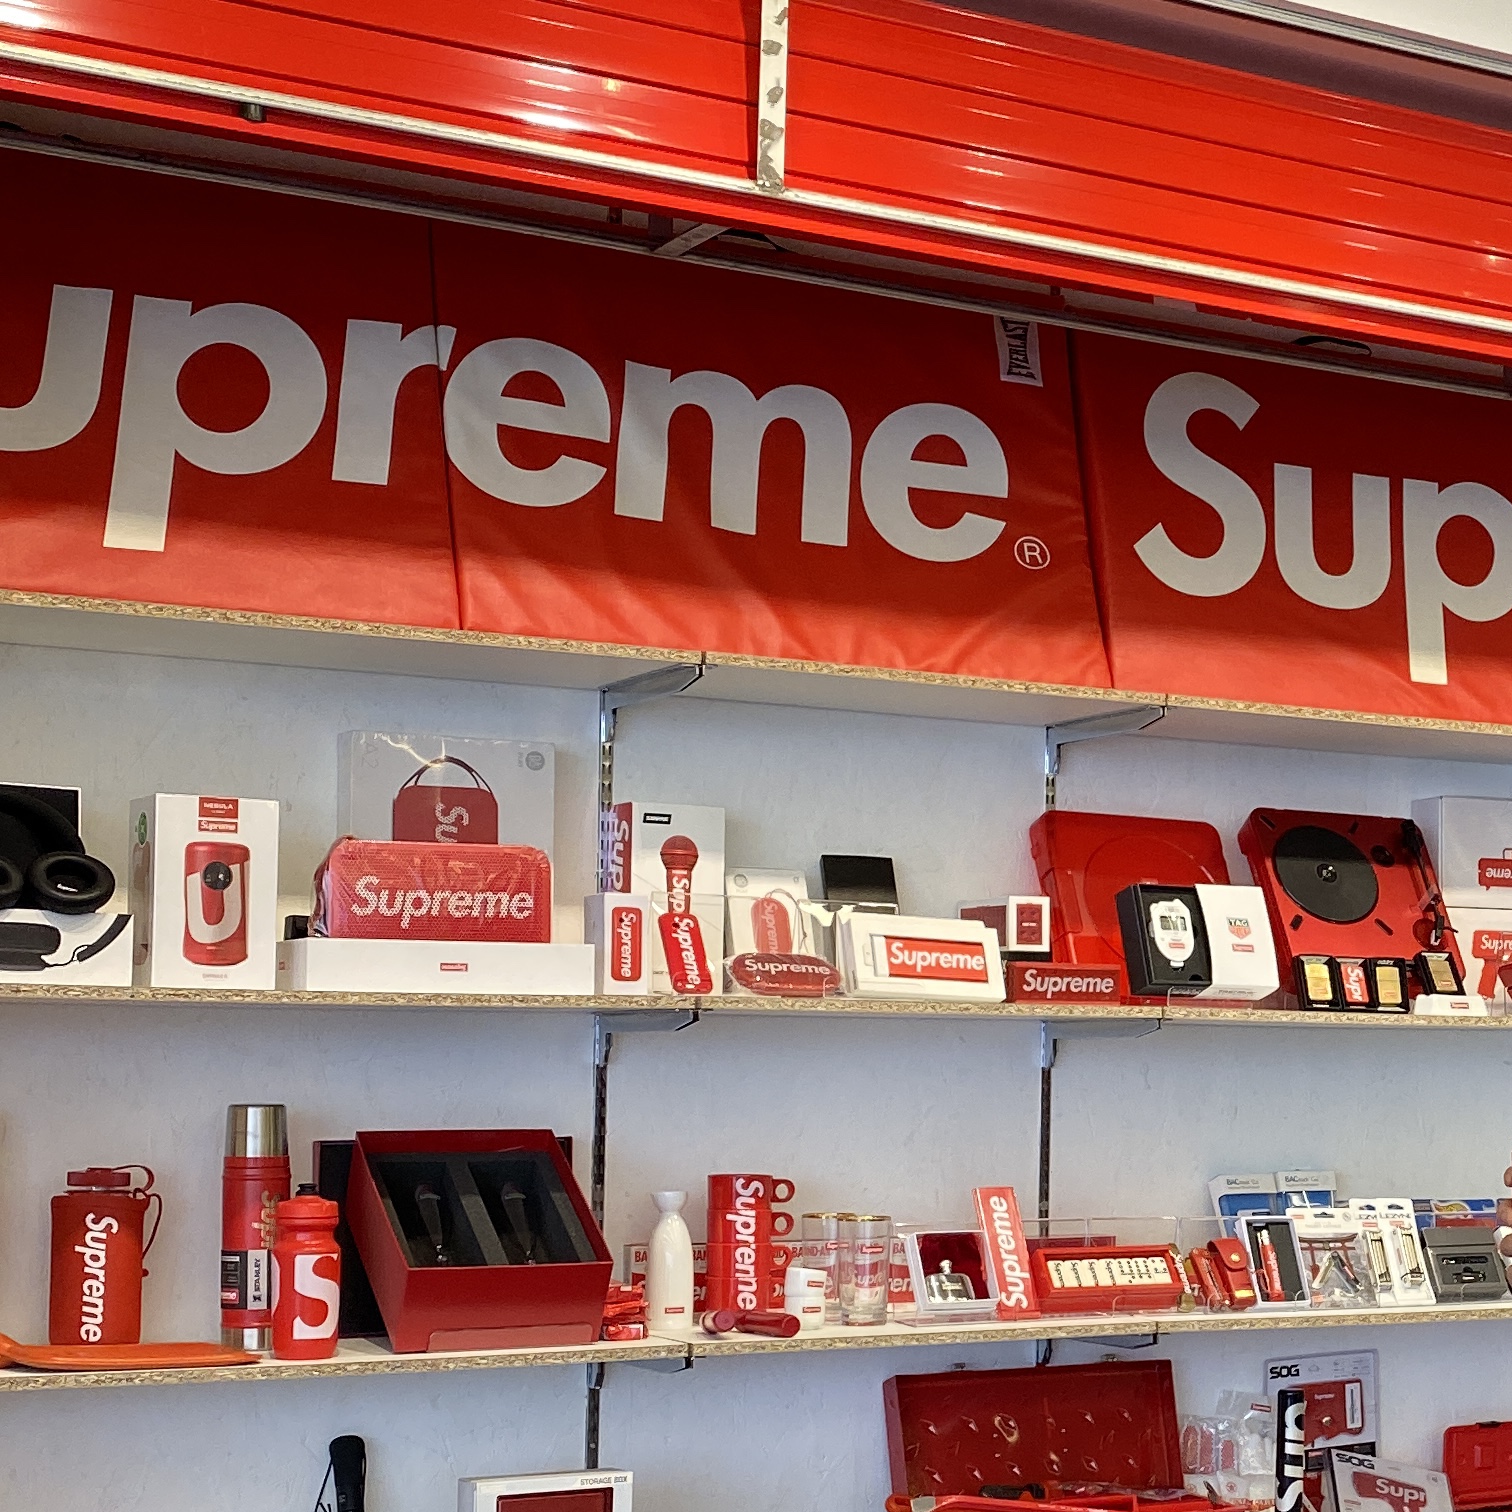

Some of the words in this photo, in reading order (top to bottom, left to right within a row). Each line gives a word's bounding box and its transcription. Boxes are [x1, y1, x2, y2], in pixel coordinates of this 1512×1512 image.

[350, 875, 535, 929] Supreme
[617, 911, 637, 978] Supreme
[761, 900, 779, 954] Suprem
[671, 916, 702, 984] Supreme
[744, 958, 832, 975] Supreme
[889, 941, 985, 973] Supreme
[1022, 968, 1114, 999] Supreme
[735, 1177, 764, 1311] Supreme
[989, 1195, 1030, 1309] Supreme
[79, 1211, 119, 1344] Supreme
[253, 1258, 261, 1292] STANLEY
[1269, 1363, 1300, 1380] SOG
[581, 1476, 612, 1486] STORAGE
[614, 1475, 628, 1484] BOX
[1335, 1453, 1375, 1470] SOG
